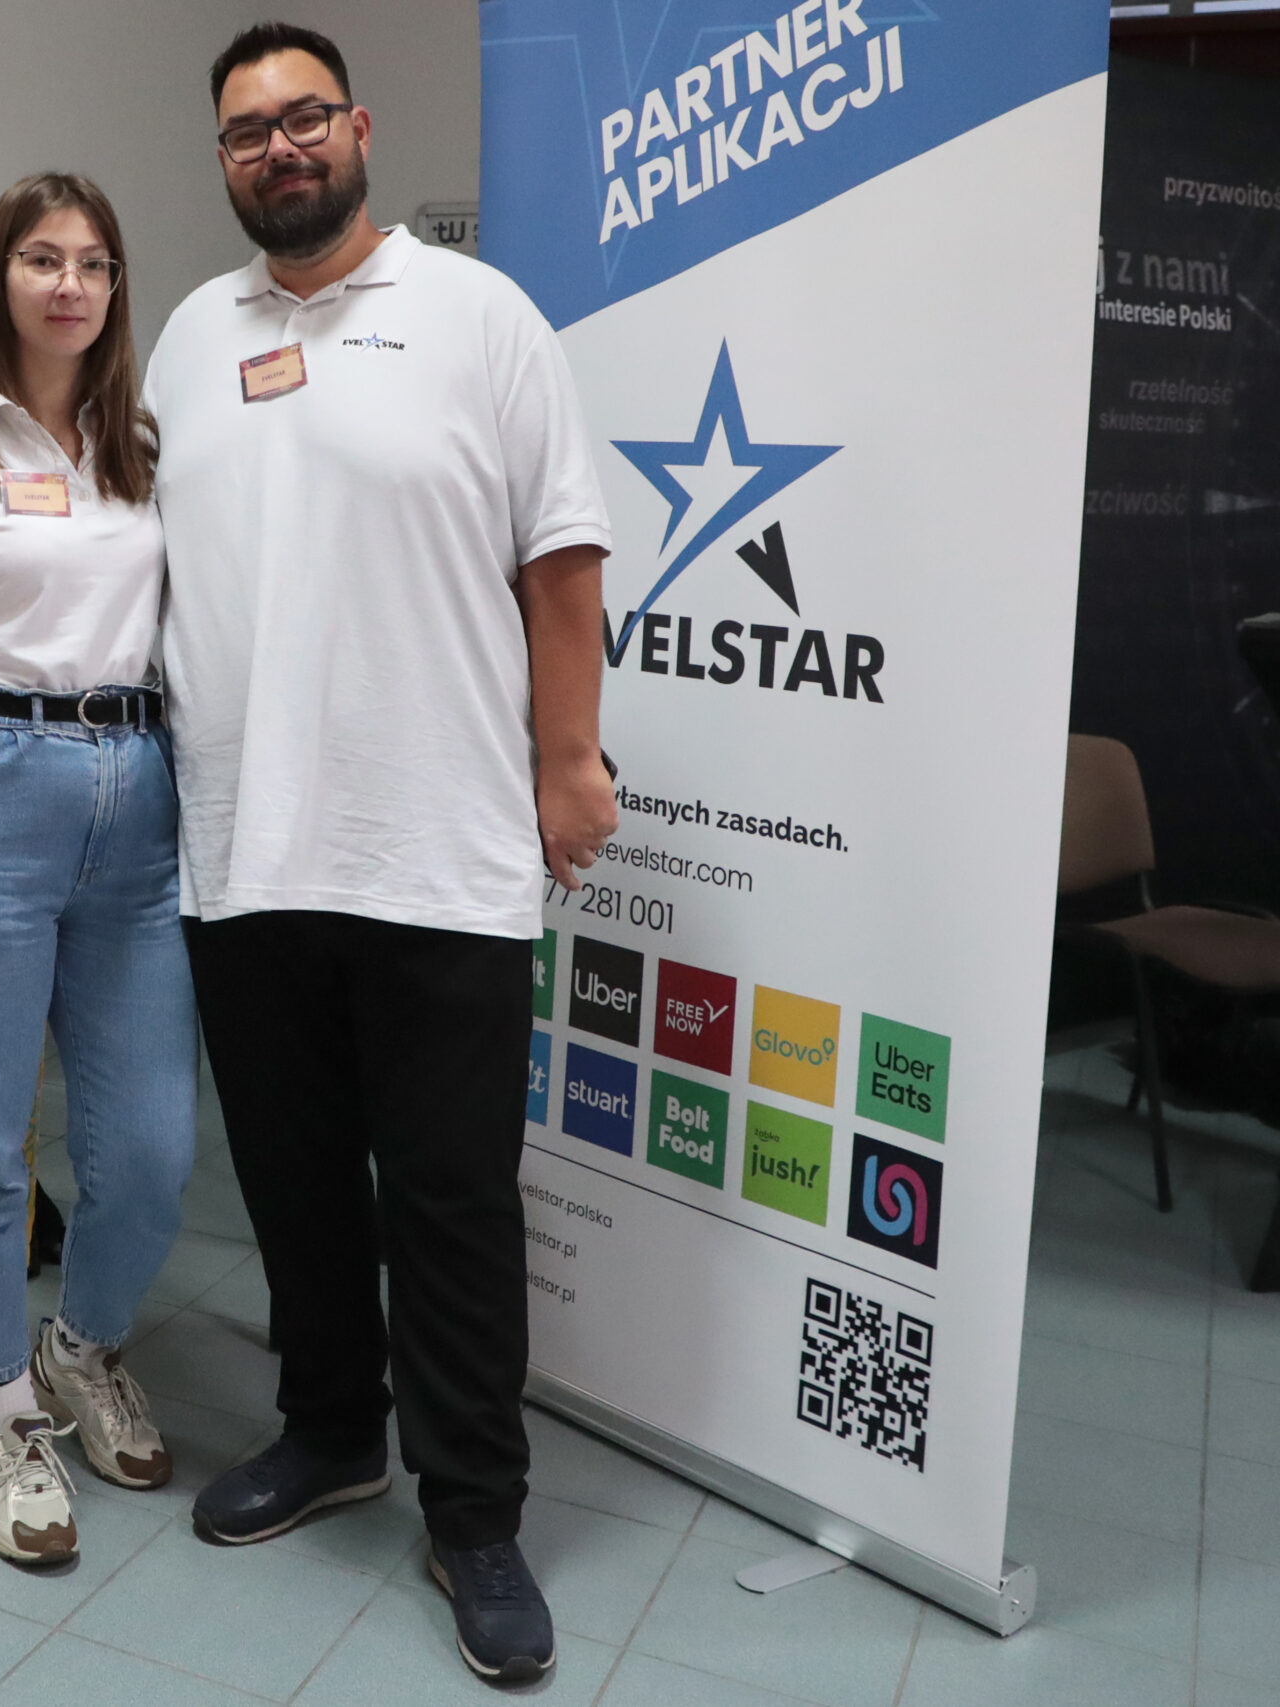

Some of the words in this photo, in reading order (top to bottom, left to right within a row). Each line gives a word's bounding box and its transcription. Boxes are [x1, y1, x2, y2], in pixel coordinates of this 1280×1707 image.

[601, 0, 868, 174] PARTNER
[599, 25, 903, 245] APLIKACJI
[1116, 250, 1133, 285] z
[1143, 252, 1230, 297] nami
[1099, 294, 1177, 327] interesie
[1179, 304, 1231, 332] Polski
[382, 341, 405, 351] STAR
[716, 810, 849, 853] zasadach.
[580, 882, 622, 921] 281
[630, 894, 673, 935] 001
[574, 968, 637, 1014] Uber
[666, 997, 705, 1022] FREE
[665, 1014, 703, 1036] NOW
[754, 1028, 824, 1066] Glovo
[874, 1040, 935, 1083] Uber
[665, 1095, 710, 1133] Bolt
[871, 1071, 932, 1114] Eats
[658, 1123, 715, 1166] Food
[751, 1144, 821, 1189] jush!
